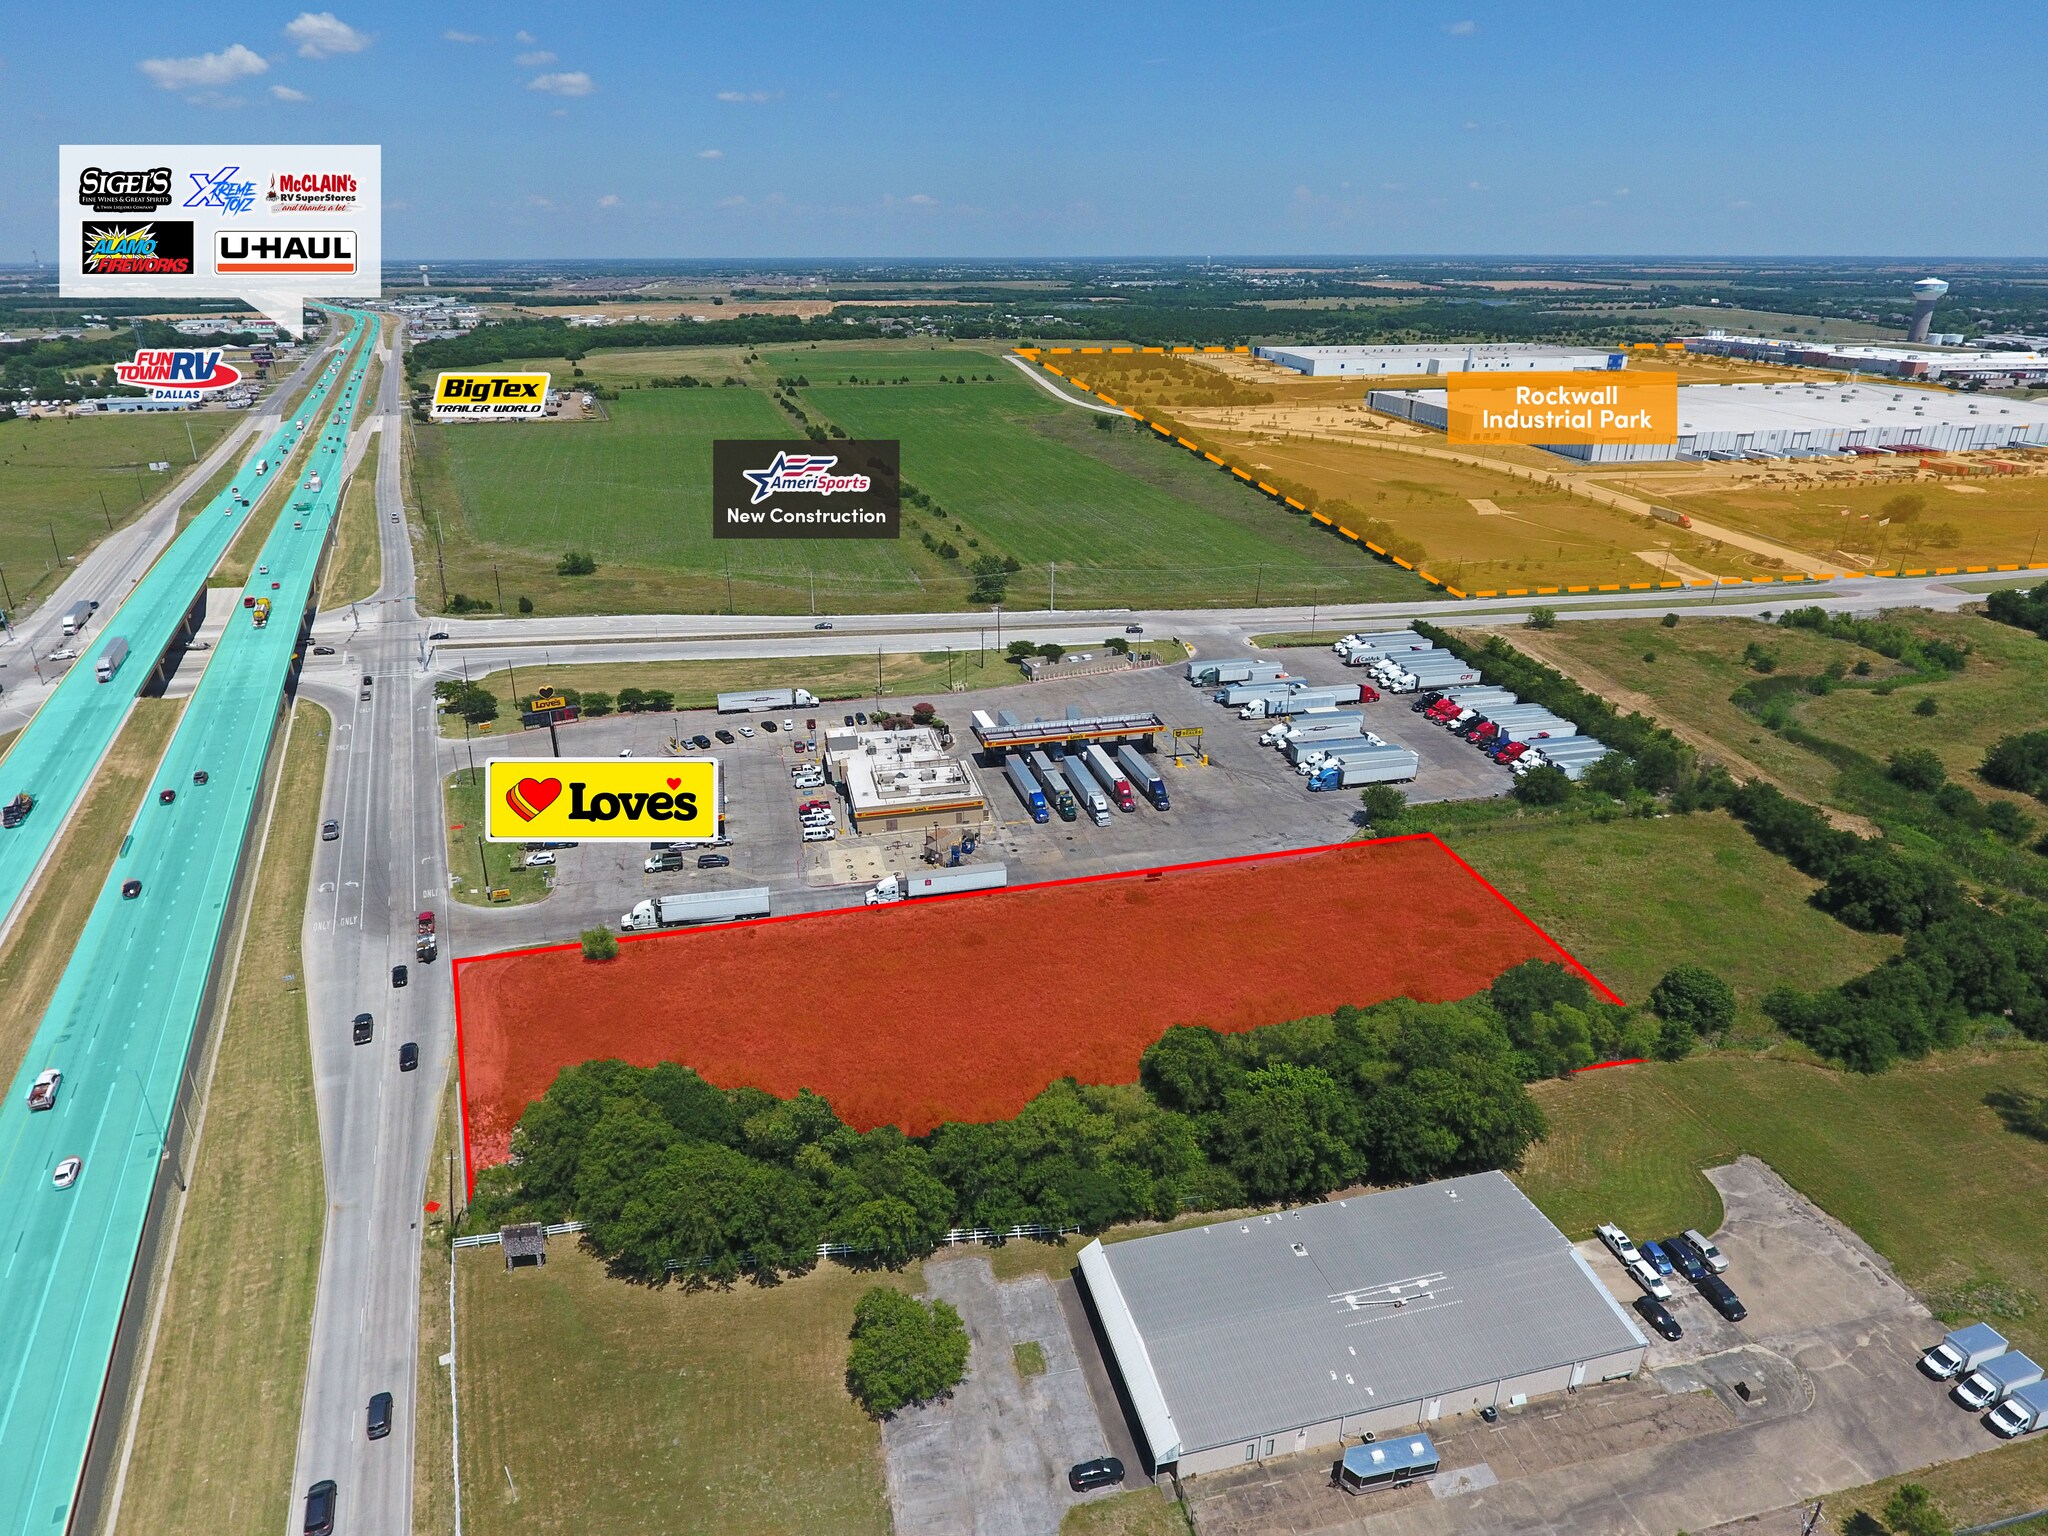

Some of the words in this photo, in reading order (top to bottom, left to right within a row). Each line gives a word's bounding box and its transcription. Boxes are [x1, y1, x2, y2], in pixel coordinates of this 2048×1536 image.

[423, 888, 439, 898] ONLY
[313, 920, 331, 931] ONLY
[340, 916, 358, 926] ONLY
